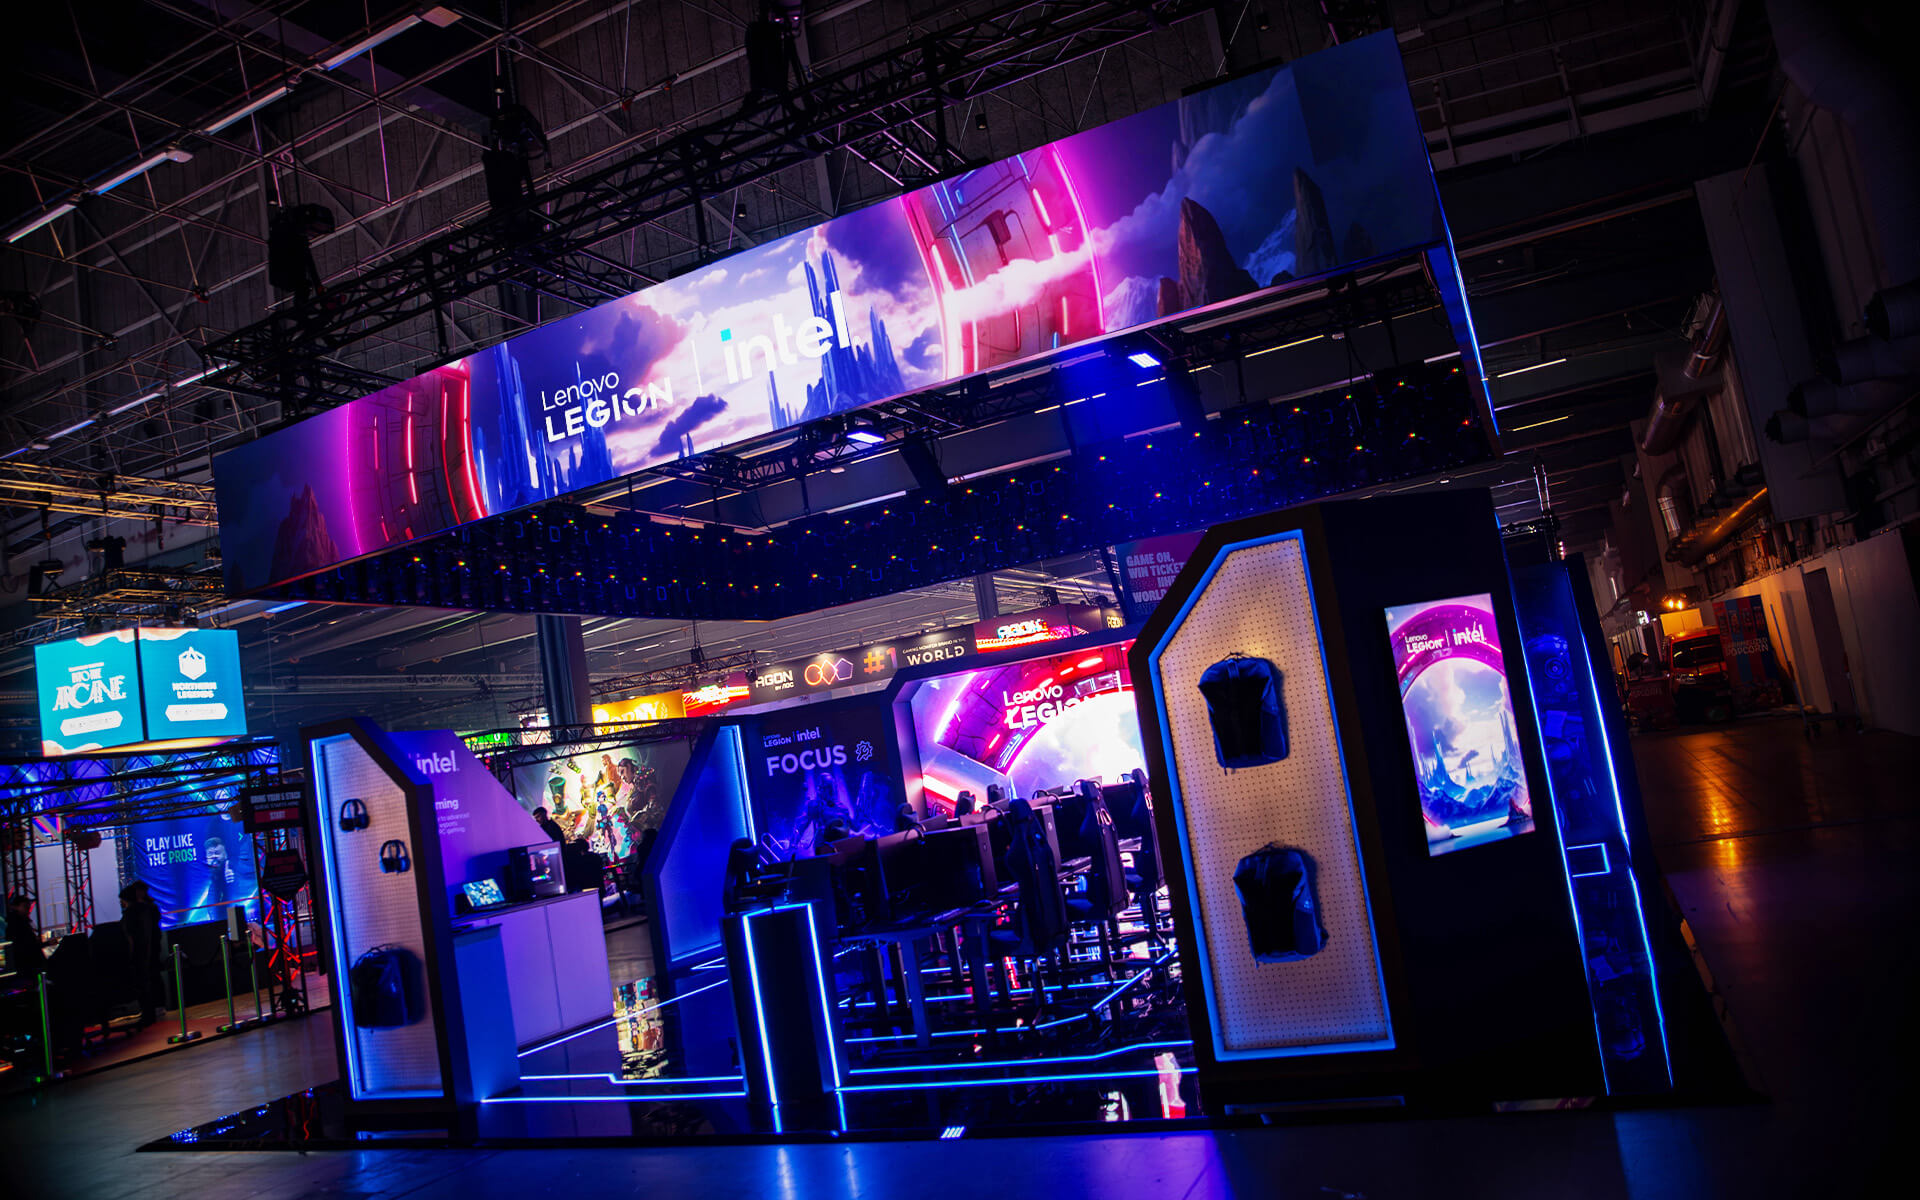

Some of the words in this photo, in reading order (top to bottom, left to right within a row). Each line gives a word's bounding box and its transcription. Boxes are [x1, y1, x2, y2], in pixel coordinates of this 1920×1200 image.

[720, 290, 851, 384] intel
[541, 371, 620, 412] Lenovo
[545, 376, 673, 443] LEGION
[1126, 554, 1155, 567] GAME
[1156, 551, 1175, 564] ON,
[1127, 566, 1150, 579] WIN
[863, 647, 897, 675] #1
[906, 645, 965, 666] WORLD
[755, 670, 793, 688] AGON
[52, 675, 127, 712] ARCANE
[1002, 684, 1064, 707] Lenovo
[764, 737, 792, 748] LEGION
[796, 727, 821, 742] intel
[766, 744, 848, 777] FOCUS
[146, 836, 170, 851] PLAY
[172, 833, 194, 848] LIKE
[148, 852, 167, 867] THE
[168, 848, 197, 864] PROS!
